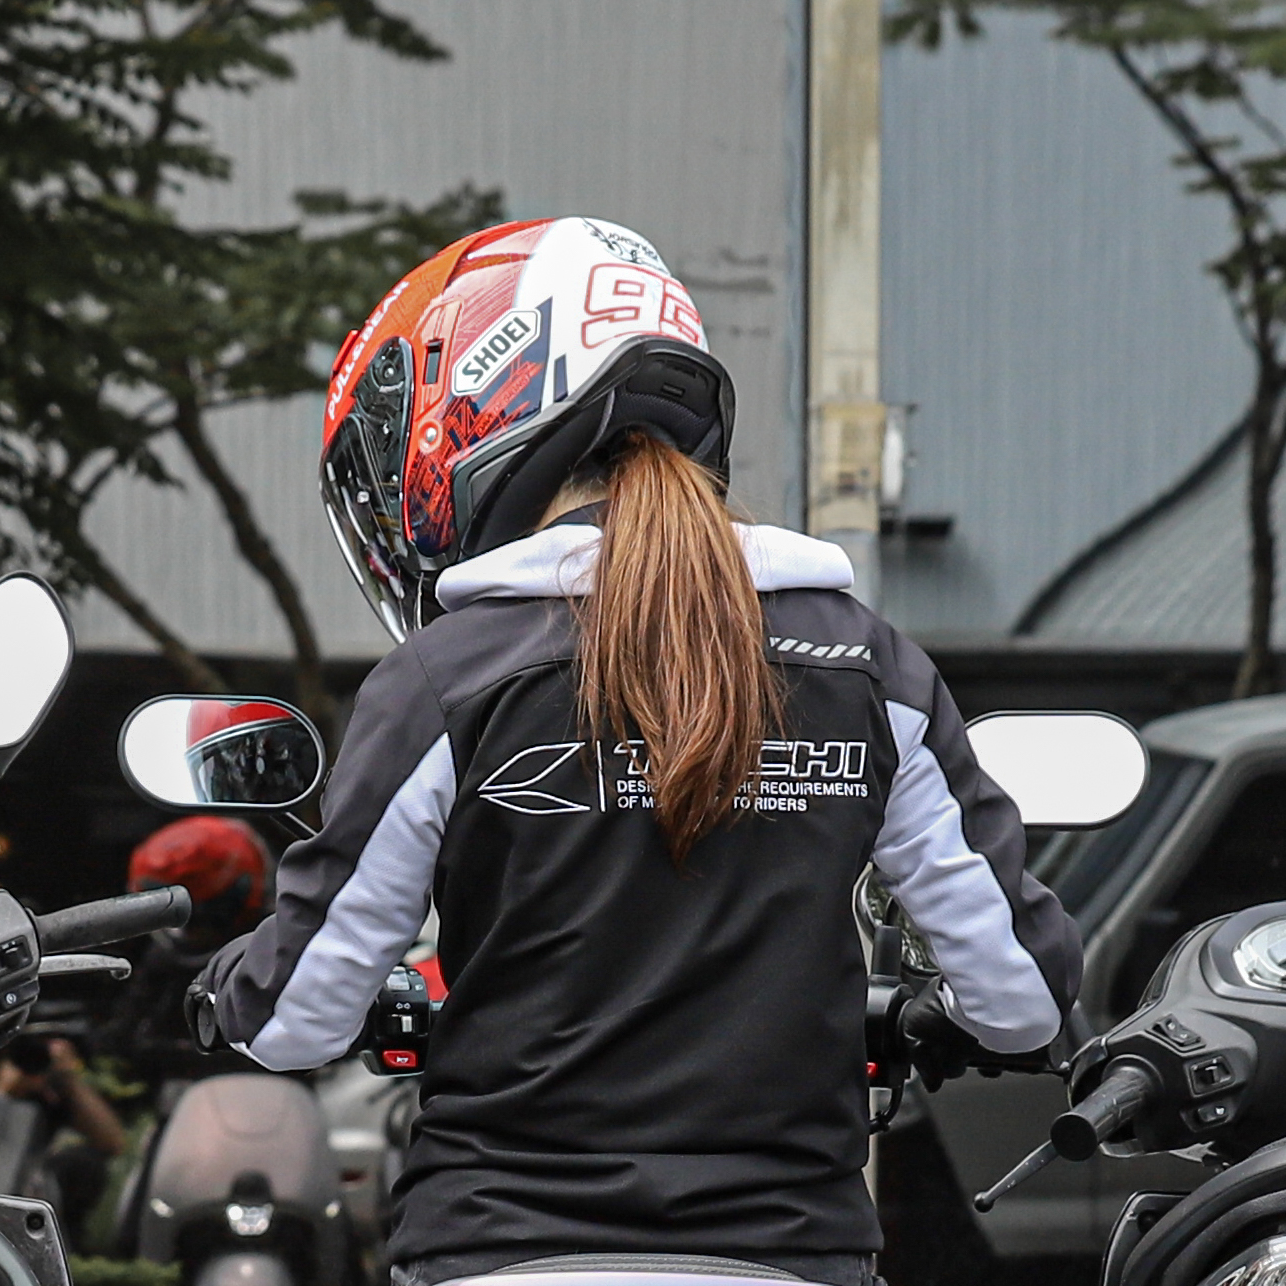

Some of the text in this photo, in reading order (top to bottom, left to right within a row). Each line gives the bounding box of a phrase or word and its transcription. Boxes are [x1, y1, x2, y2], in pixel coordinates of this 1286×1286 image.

[461, 315, 532, 385] SHOEI
[613, 739, 867, 779] TCHI
[760, 781, 868, 797] REQUIREMENTS
[617, 795, 639, 809] OF
[755, 797, 807, 813] RIDERS
